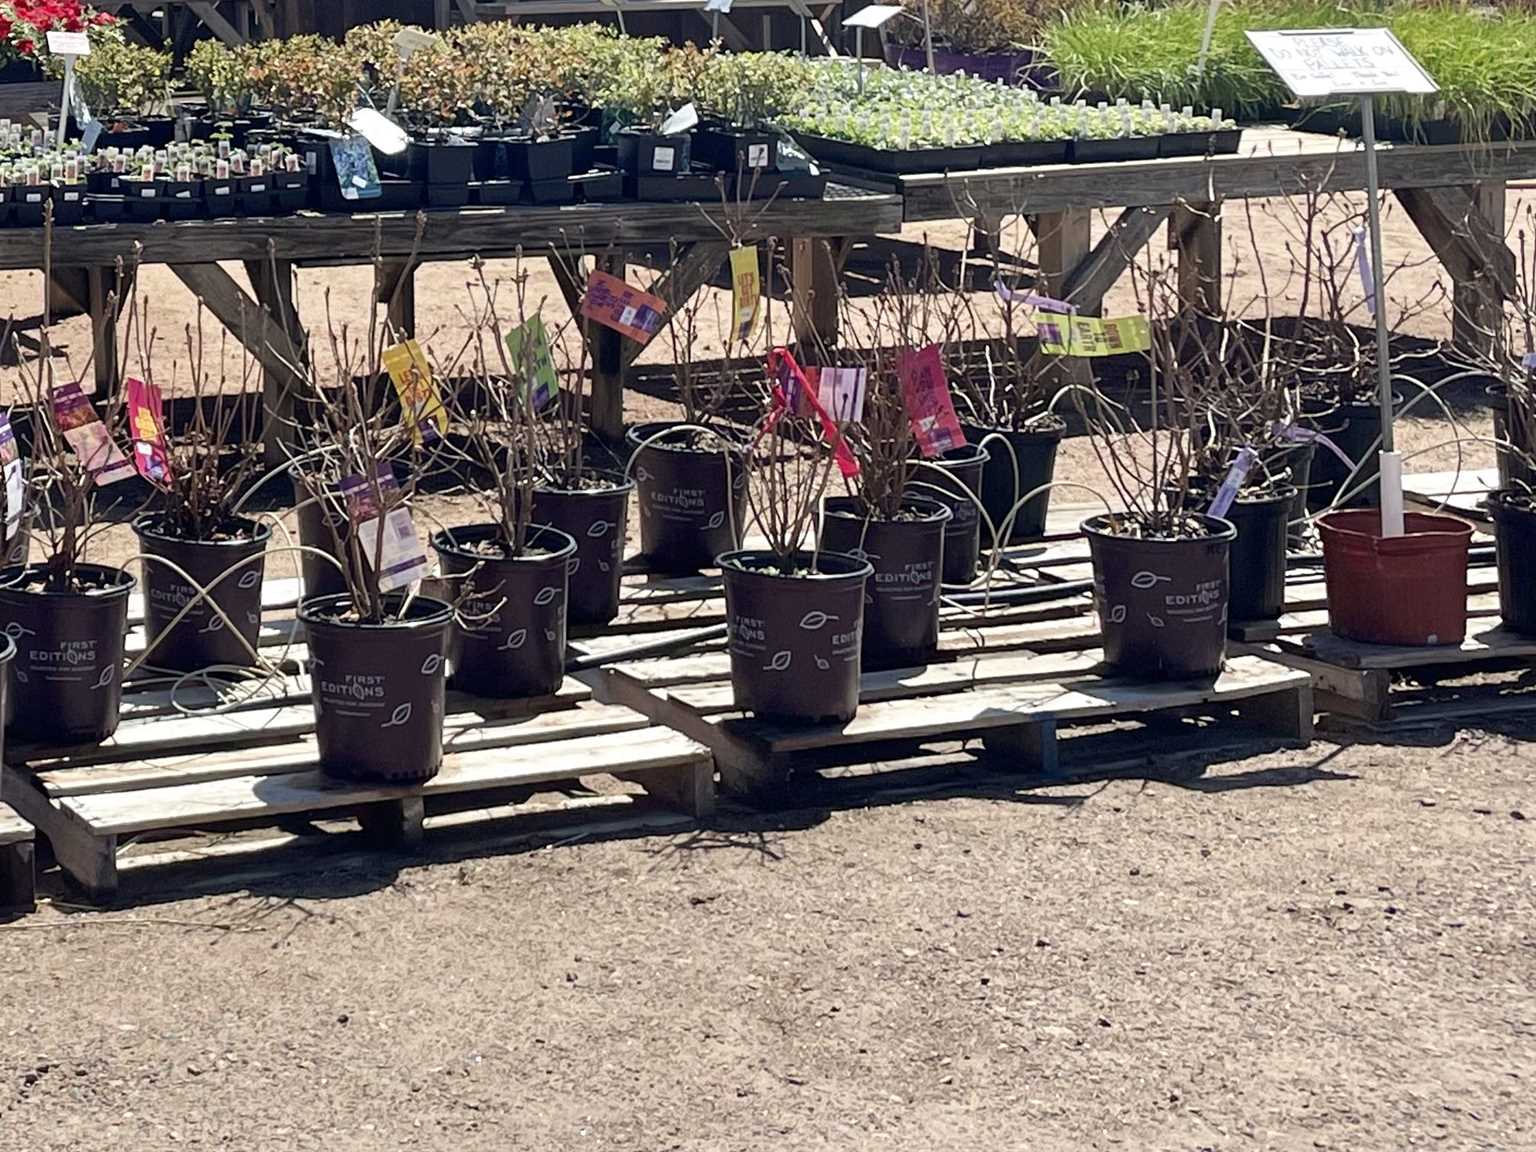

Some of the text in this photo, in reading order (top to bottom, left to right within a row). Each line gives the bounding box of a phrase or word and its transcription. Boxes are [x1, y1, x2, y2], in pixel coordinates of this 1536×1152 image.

[60, 640, 98, 650] FIRST
[29, 649, 97, 665] EDITIONS
[345, 674, 385, 685] FIRST
[321, 681, 385, 700] EDITIONS
